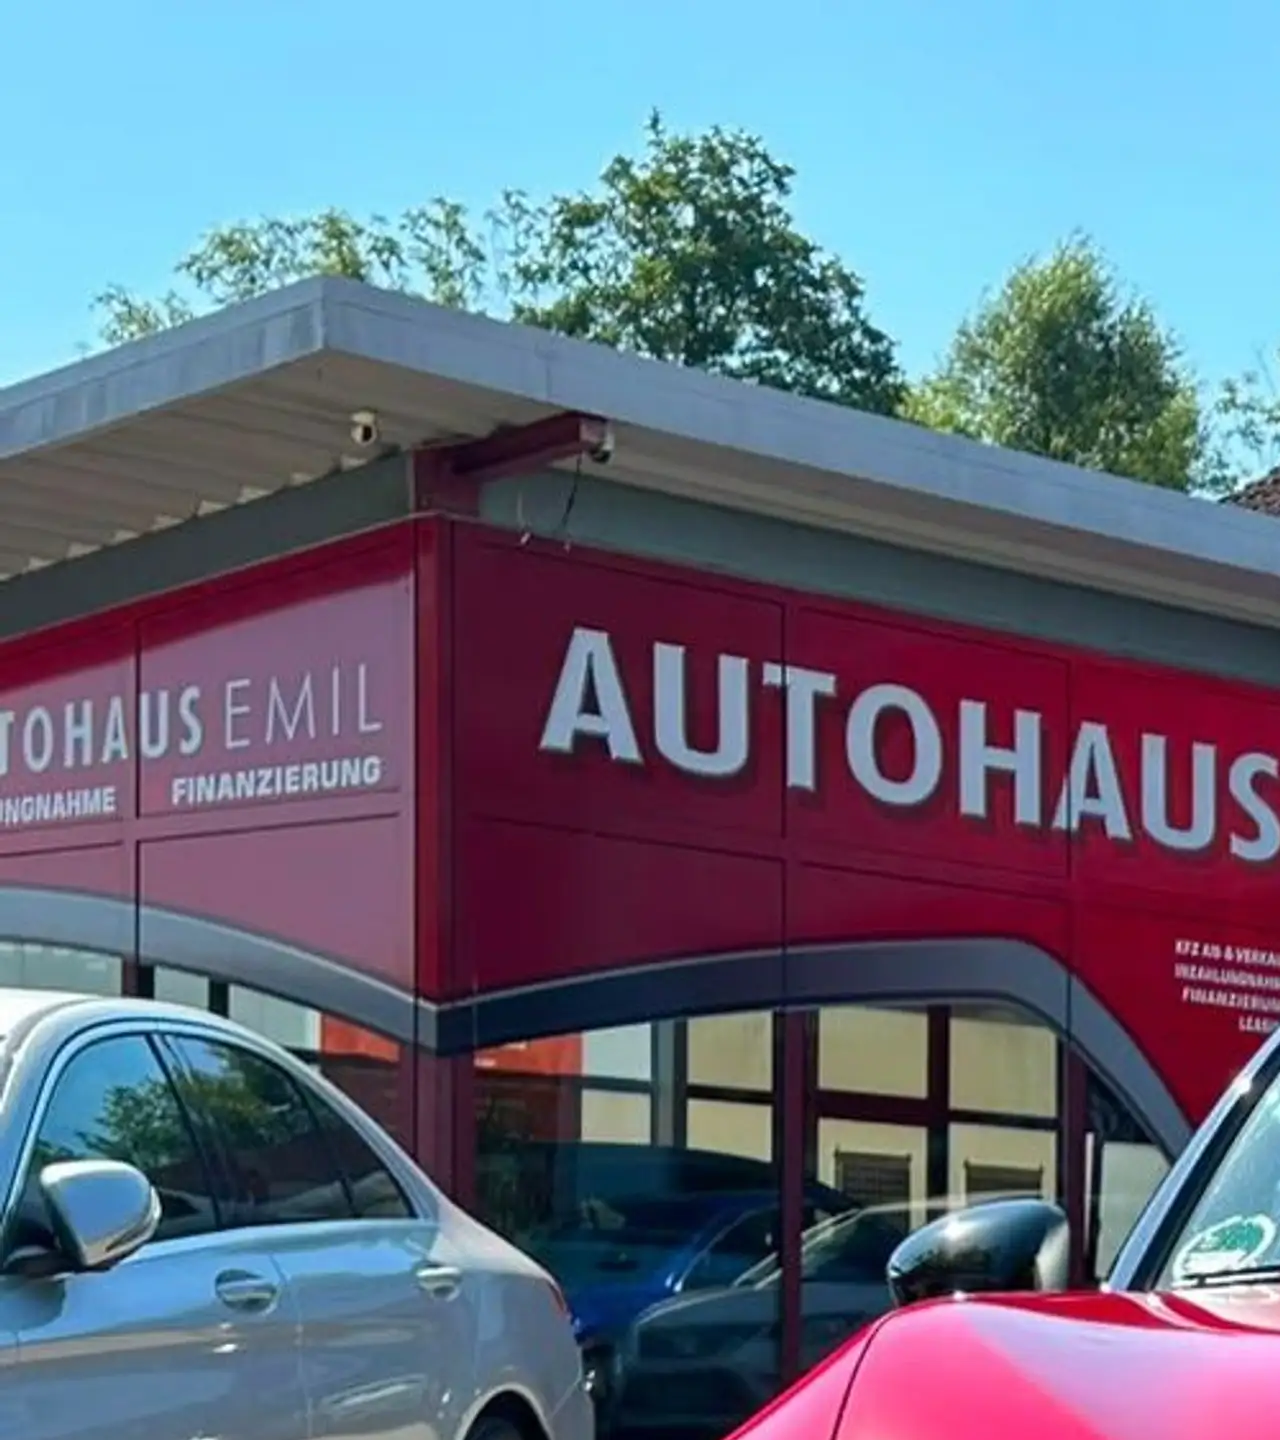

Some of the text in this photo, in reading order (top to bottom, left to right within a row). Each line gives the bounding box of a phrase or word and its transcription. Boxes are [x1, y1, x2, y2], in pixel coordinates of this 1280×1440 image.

[224, 662, 383, 751] EMIL
[171, 755, 382, 806] FINANZIERUNG
[0, 785, 118, 828] NGNAHME
